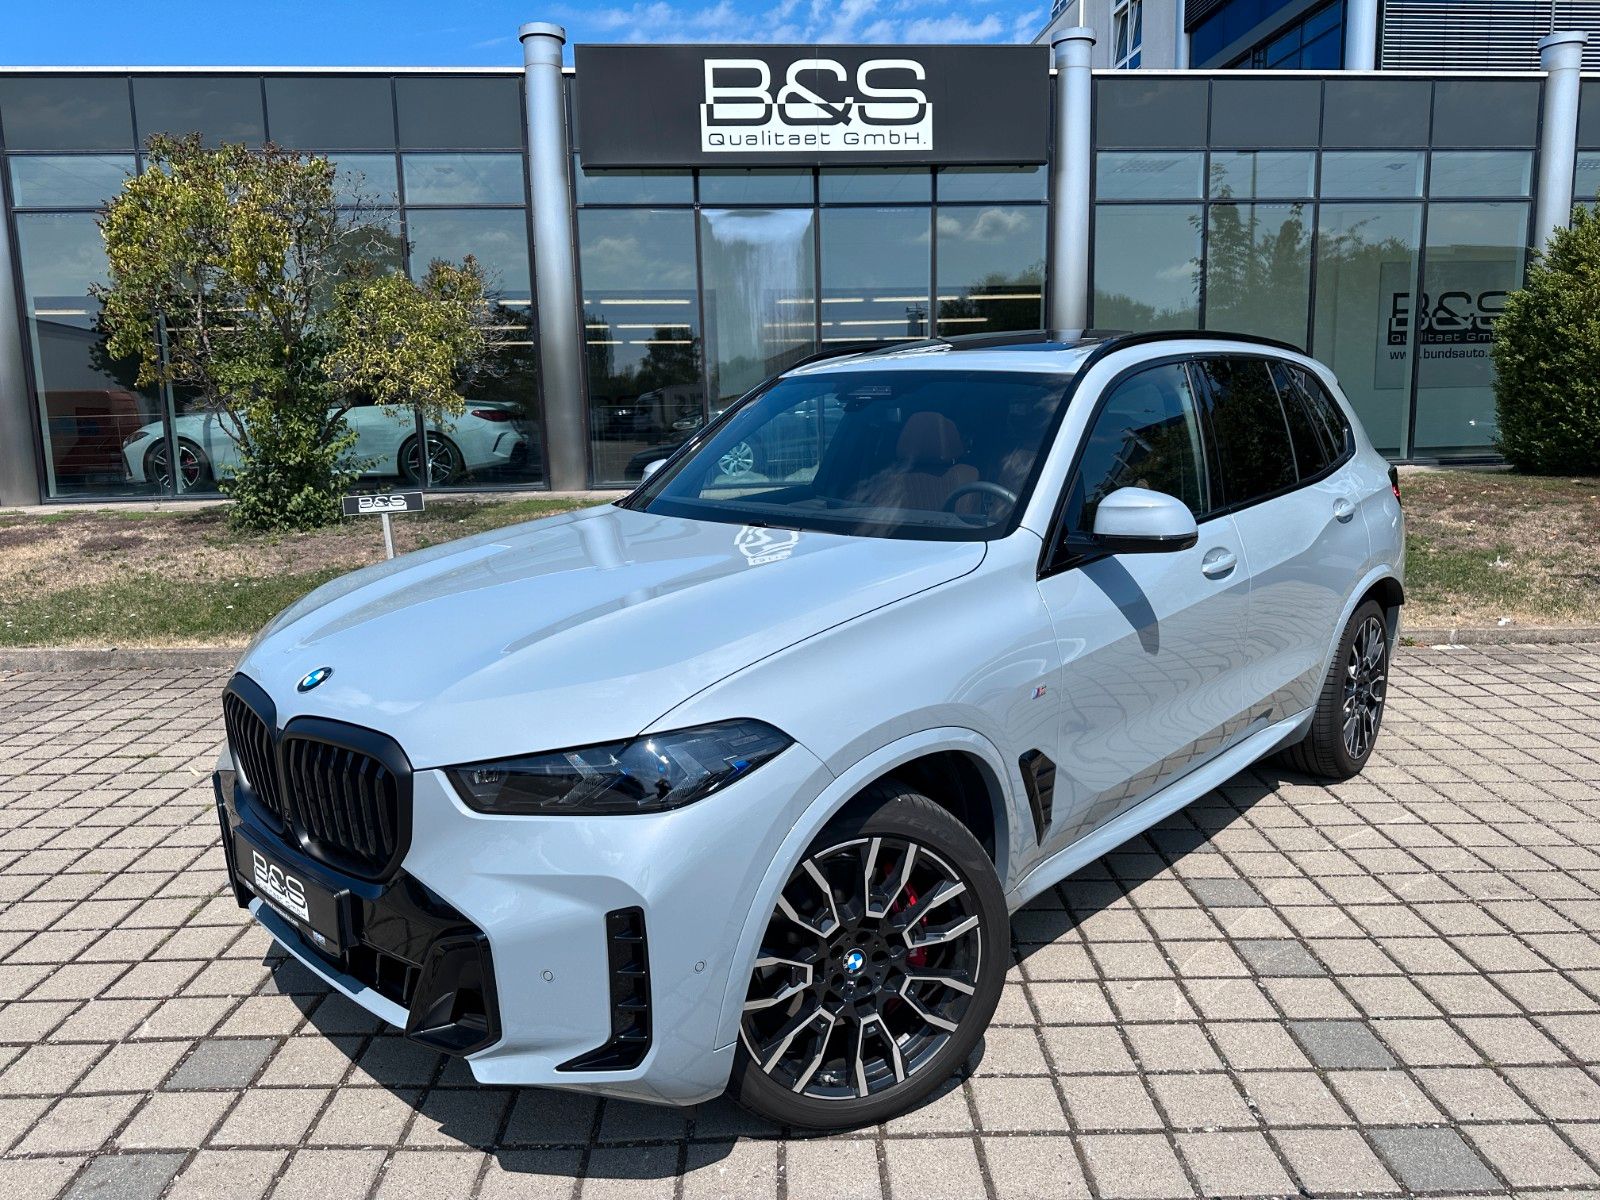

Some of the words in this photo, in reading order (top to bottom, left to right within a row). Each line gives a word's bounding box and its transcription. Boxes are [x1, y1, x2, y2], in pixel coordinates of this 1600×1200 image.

[704, 59, 928, 127] B&S
[708, 130, 831, 146] Qualitaet
[843, 131, 927, 145] GmbH.
[1392, 291, 1508, 331] B&S
[1391, 333, 1460, 342] Qulitaet
[359, 496, 405, 509] B&S
[252, 850, 306, 909] B&S
